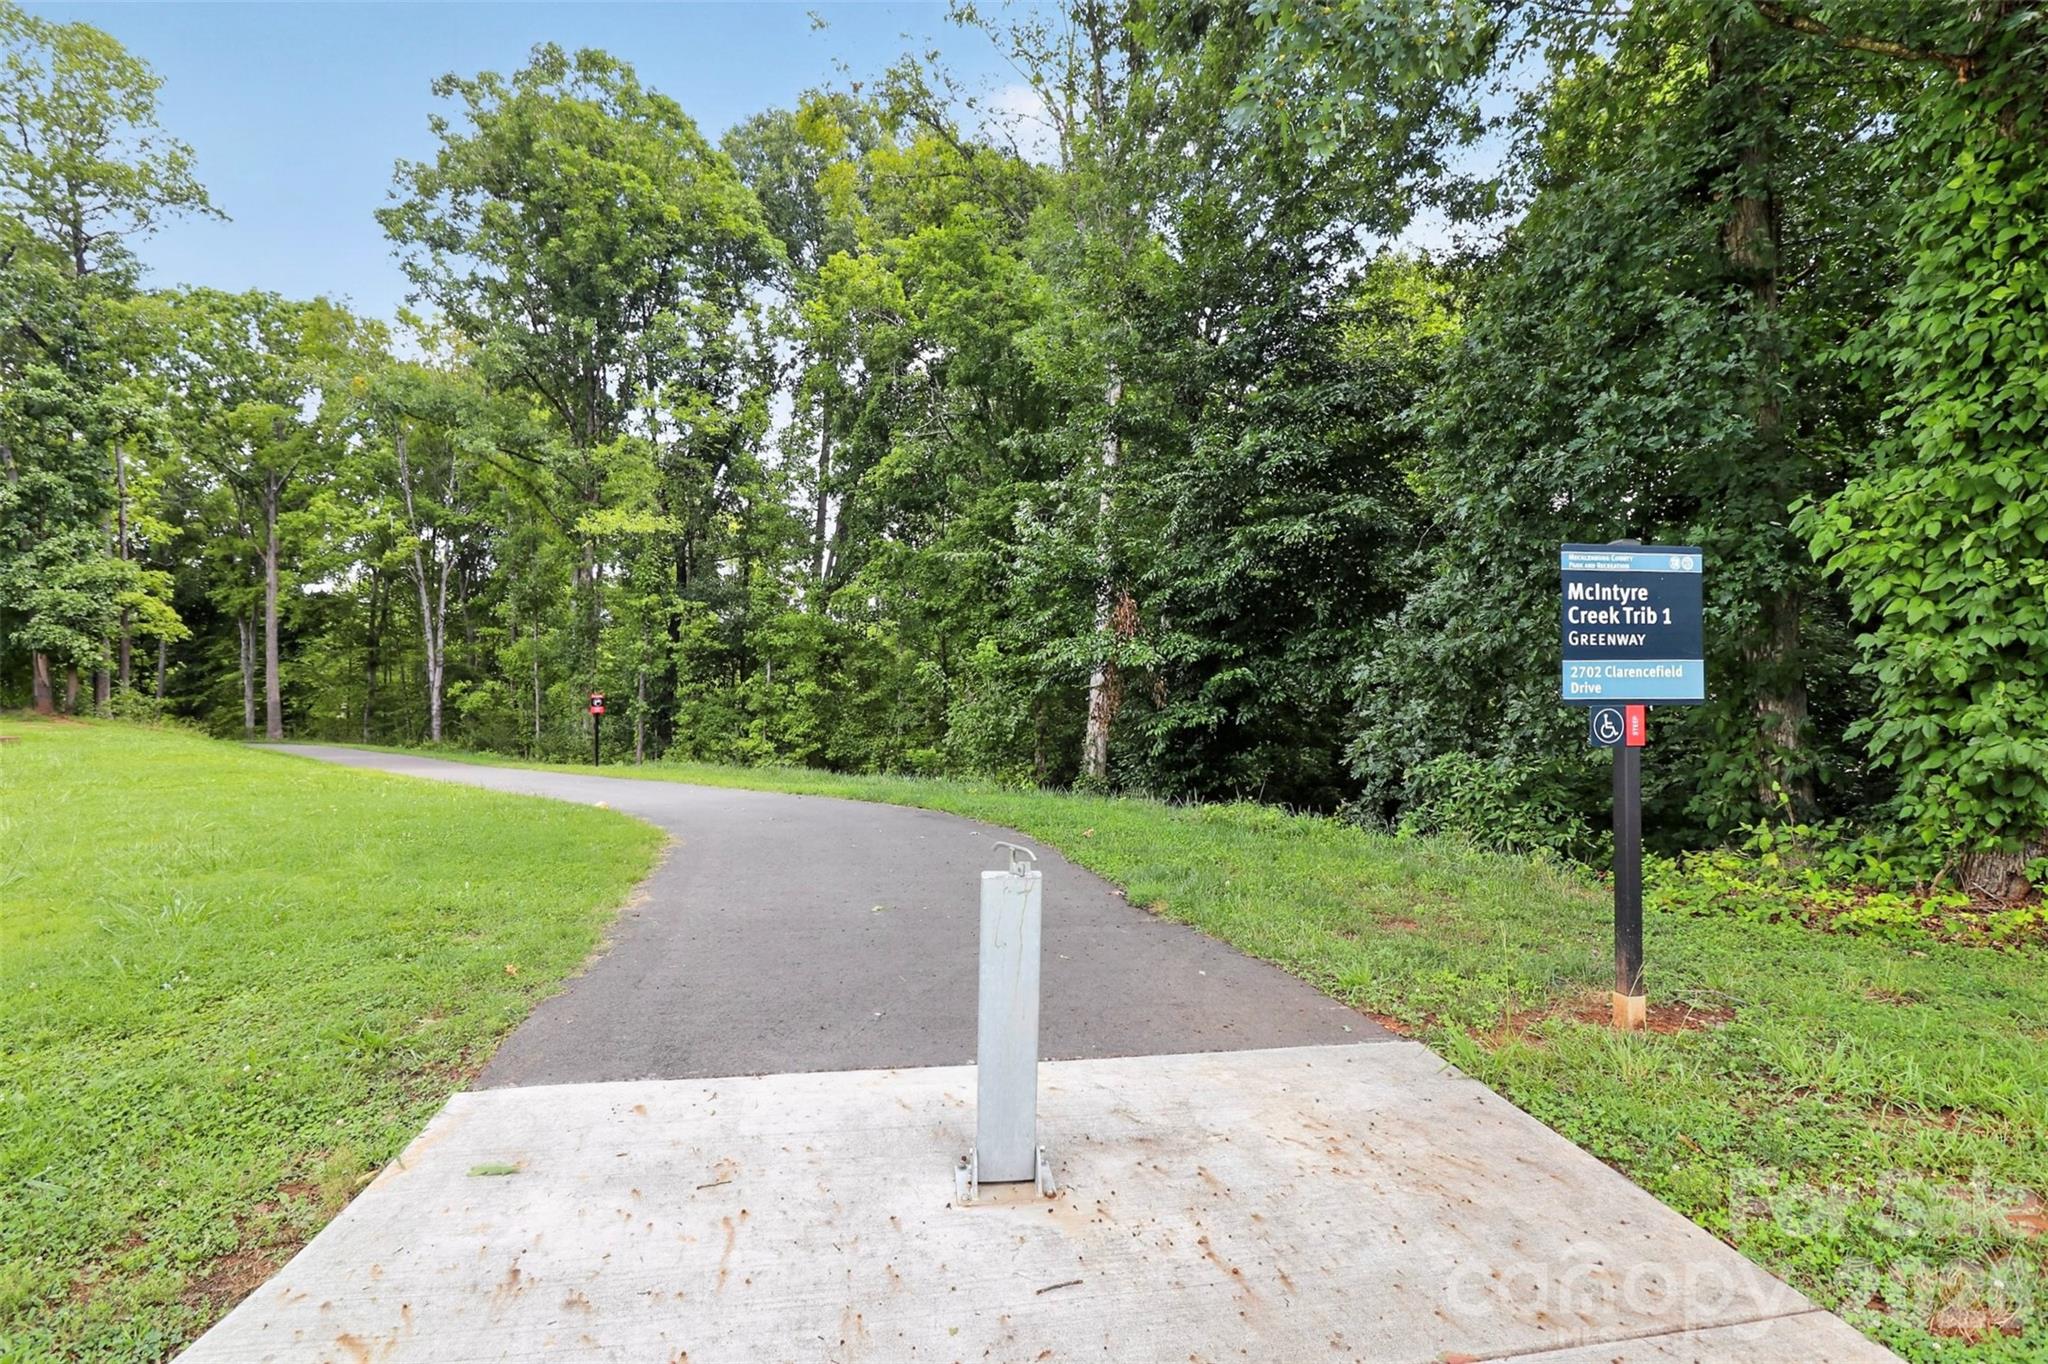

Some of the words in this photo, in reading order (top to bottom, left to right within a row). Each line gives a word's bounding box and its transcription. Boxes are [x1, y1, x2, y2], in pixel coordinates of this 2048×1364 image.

[1568, 583, 1648, 605] McIntyre
[1568, 606, 1620, 624] Creek
[1622, 606, 1658, 624] Trib
[1662, 608, 1672, 624] 1
[1571, 667, 1602, 678] 2702
[1605, 665, 1683, 678] Clarencefield
[1571, 682, 1602, 693] Drive
